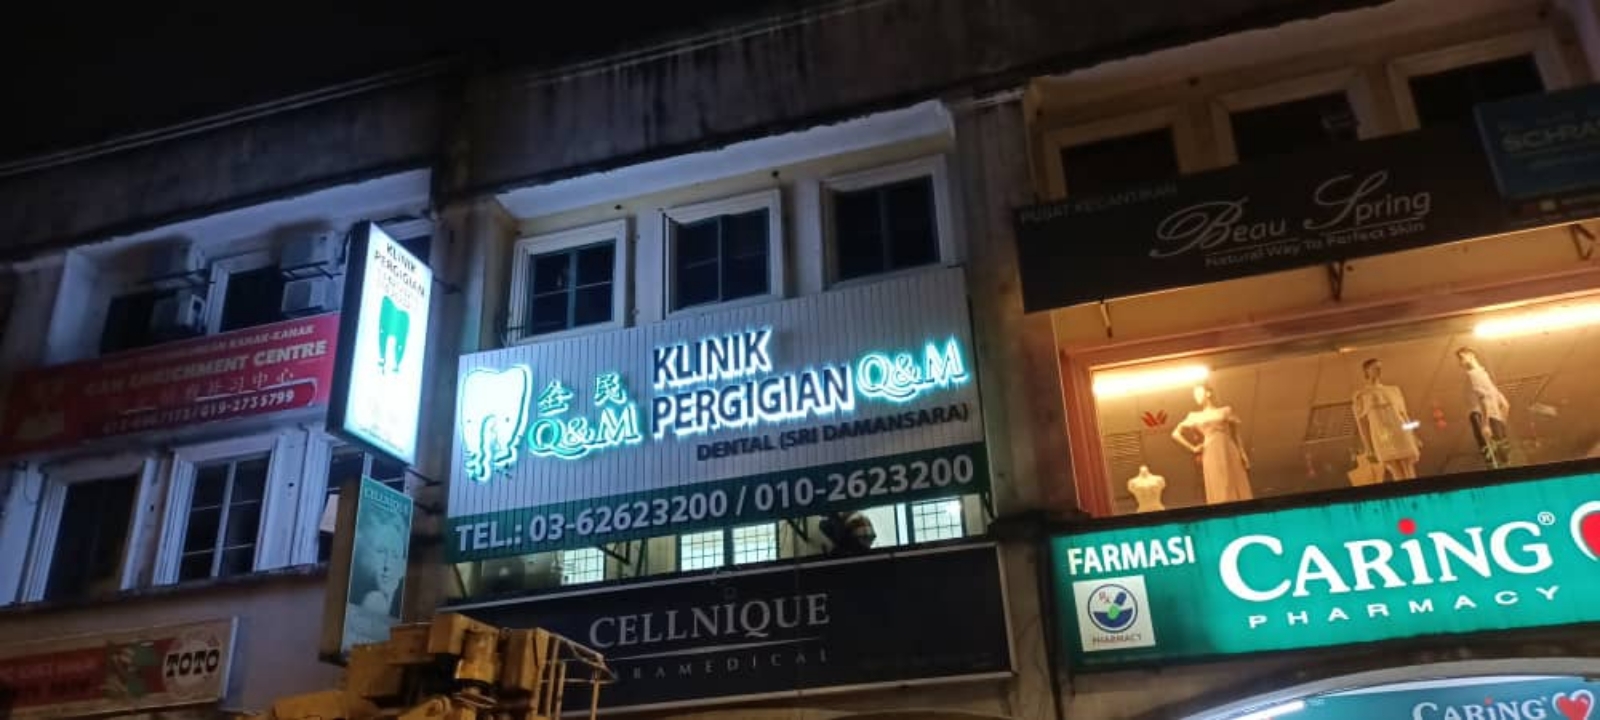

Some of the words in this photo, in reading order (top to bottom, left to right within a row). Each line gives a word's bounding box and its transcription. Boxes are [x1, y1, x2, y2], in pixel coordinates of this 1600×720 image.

[1149, 197, 1287, 257] Beau
[1303, 170, 1431, 231] Spring
[1388, 221, 1425, 238] Skin
[253, 339, 328, 368] CENTRE
[652, 329, 772, 386] KLINIK
[854, 335, 969, 400] Q&M
[651, 363, 852, 438] PERGIGIAN
[527, 403, 643, 460] Q&M
[696, 433, 776, 461] DENTAL
[779, 424, 819, 452] (SRI
[822, 402, 969, 442] DAMANSARA)
[528, 489, 729, 543] 03-62623200
[754, 454, 974, 512] 010-2623200
[1067, 535, 1196, 576] FARMASI
[589, 592, 831, 649] CELLNIQUE
[1249, 586, 1560, 629] PHARMACY
[165, 649, 220, 678] TOTO
